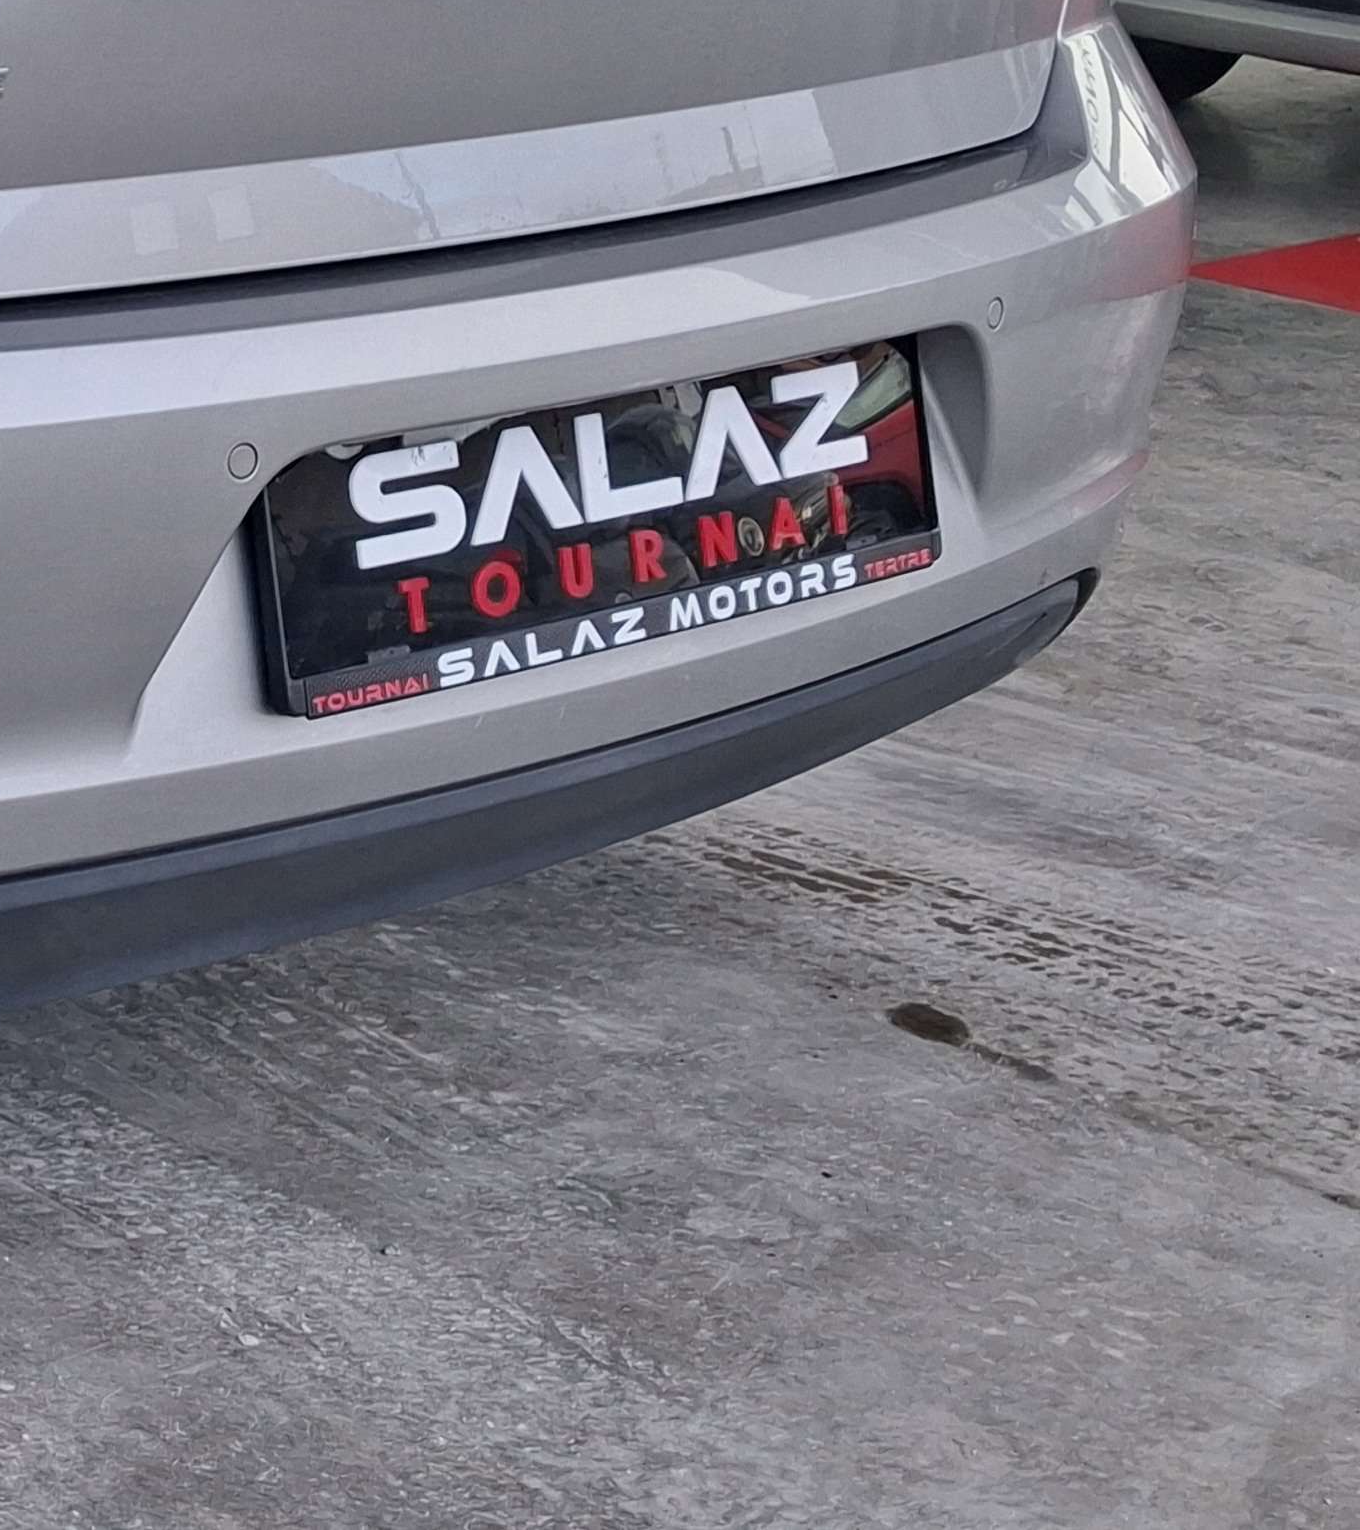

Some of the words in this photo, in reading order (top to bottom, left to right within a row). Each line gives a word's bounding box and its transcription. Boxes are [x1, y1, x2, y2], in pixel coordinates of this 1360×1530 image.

[350, 361, 868, 569] SALAZ
[312, 672, 430, 714] TOURNAI
[437, 607, 647, 688] SALAZ
[669, 553, 857, 632] MOTORS
[863, 547, 935, 579] TERTRE
[397, 483, 852, 634] TOURNAI
